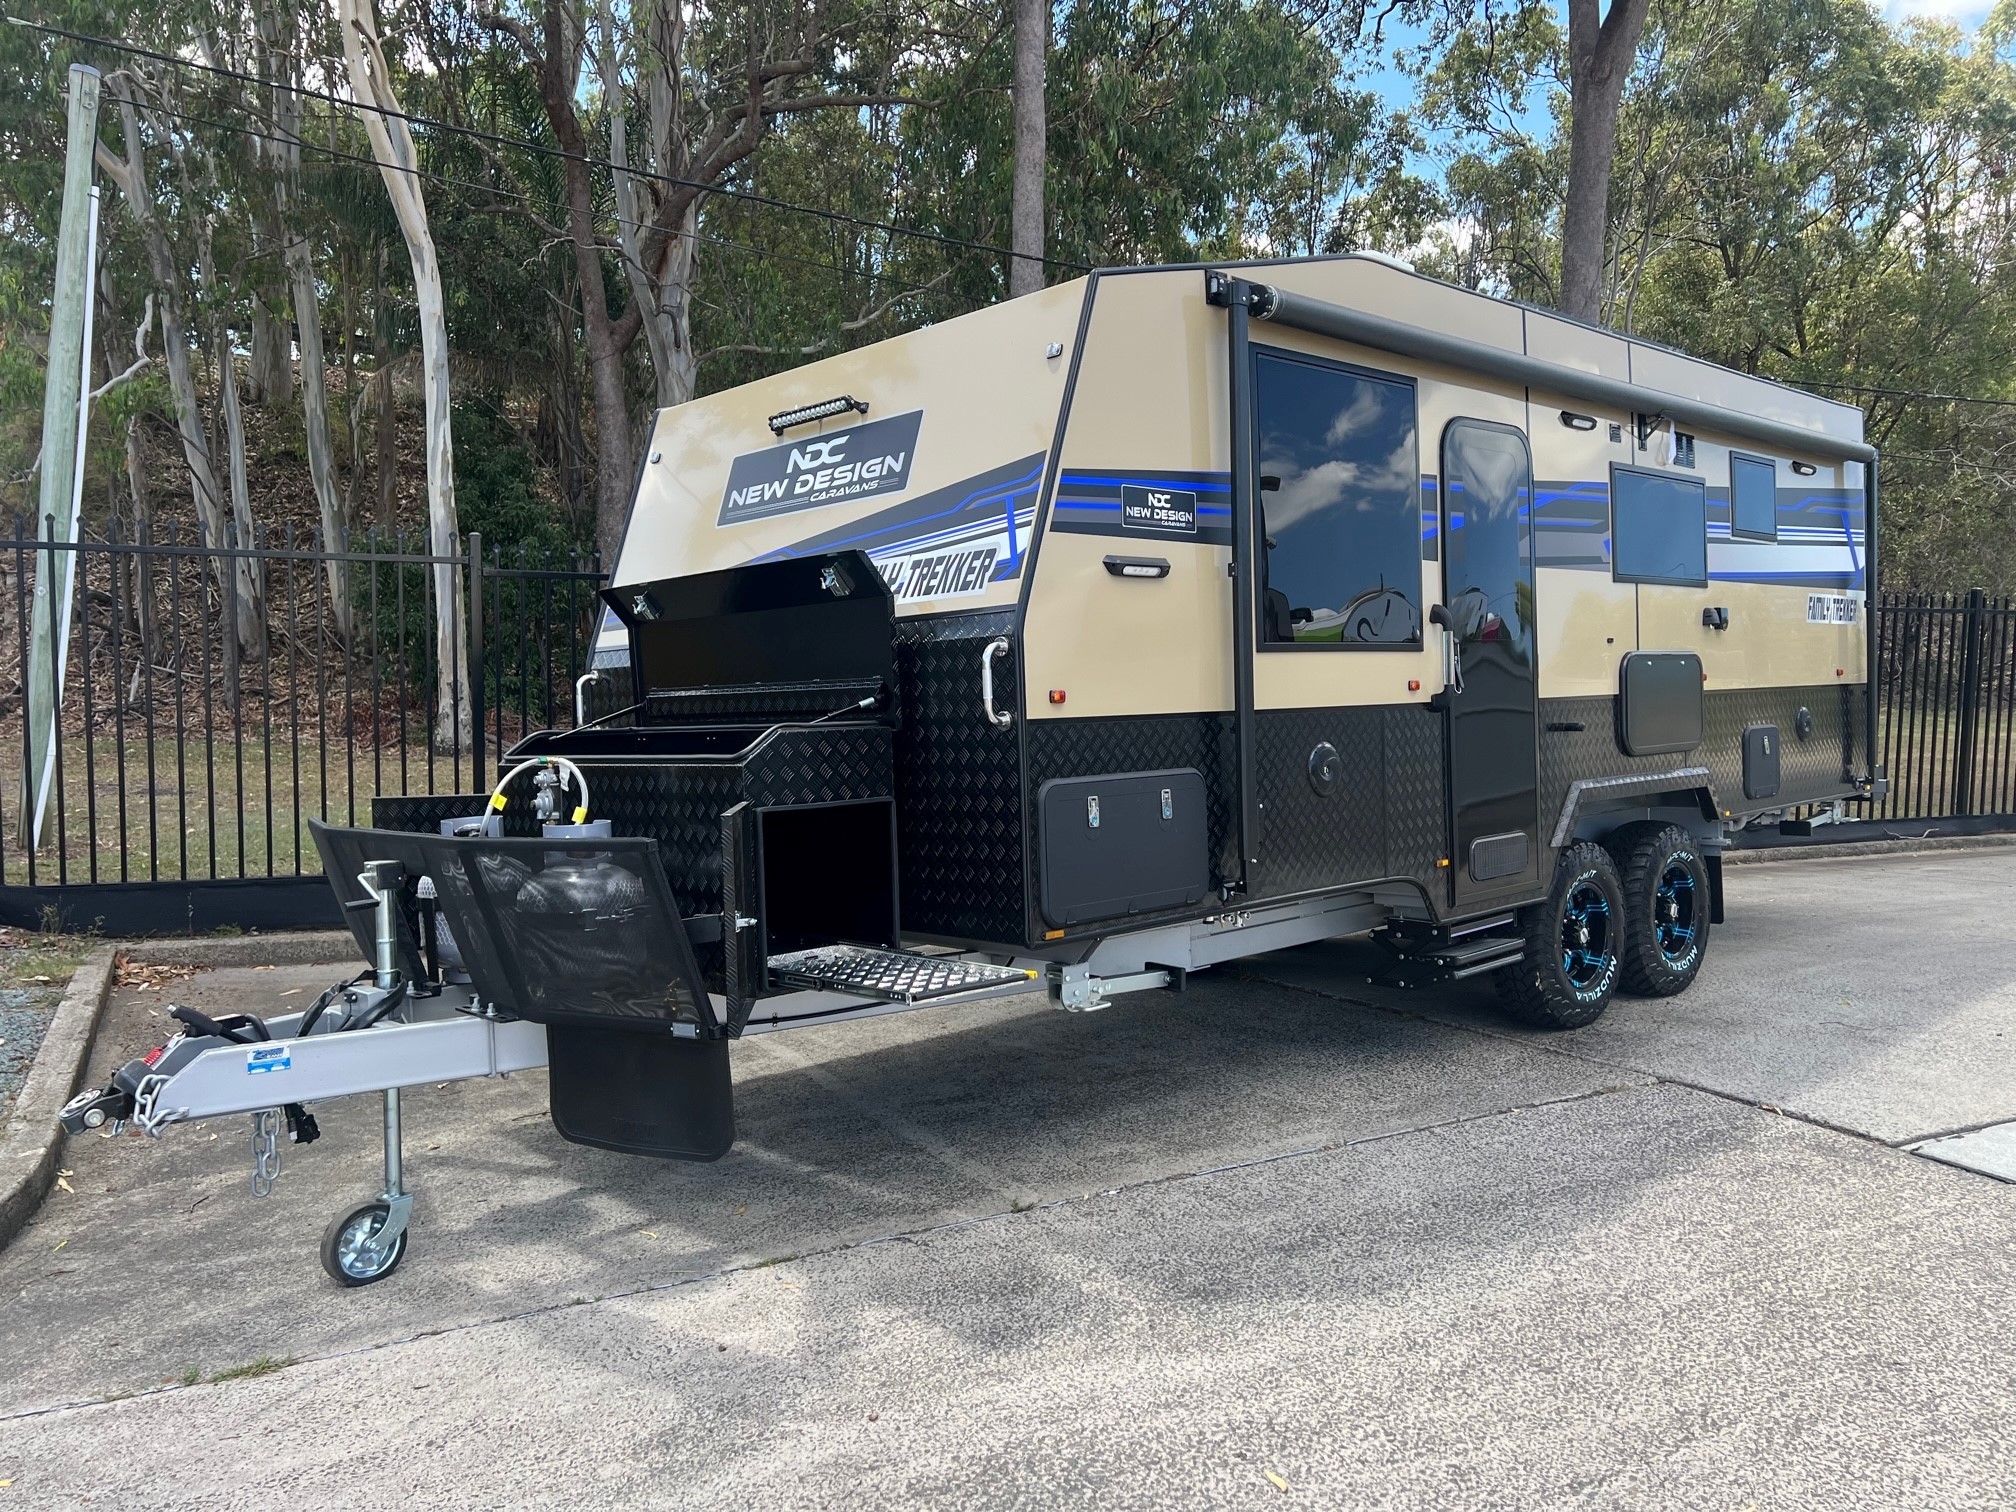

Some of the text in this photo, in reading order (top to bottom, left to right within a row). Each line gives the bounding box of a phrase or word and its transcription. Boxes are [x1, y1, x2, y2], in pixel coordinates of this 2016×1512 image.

[786, 435, 850, 474] NDC
[728, 452, 905, 508] NEW DESIGN
[809, 479, 880, 502] CARAVANS
[1148, 492, 1171, 508] NDC
[1126, 505, 1193, 523] NEW DESIGN
[1161, 520, 1186, 528] CARAVANS
[902, 547, 998, 599] TREKKER
[1808, 596, 1858, 622] FAMILY TREKKER
[1576, 955, 1617, 1002] MUDZILLA
